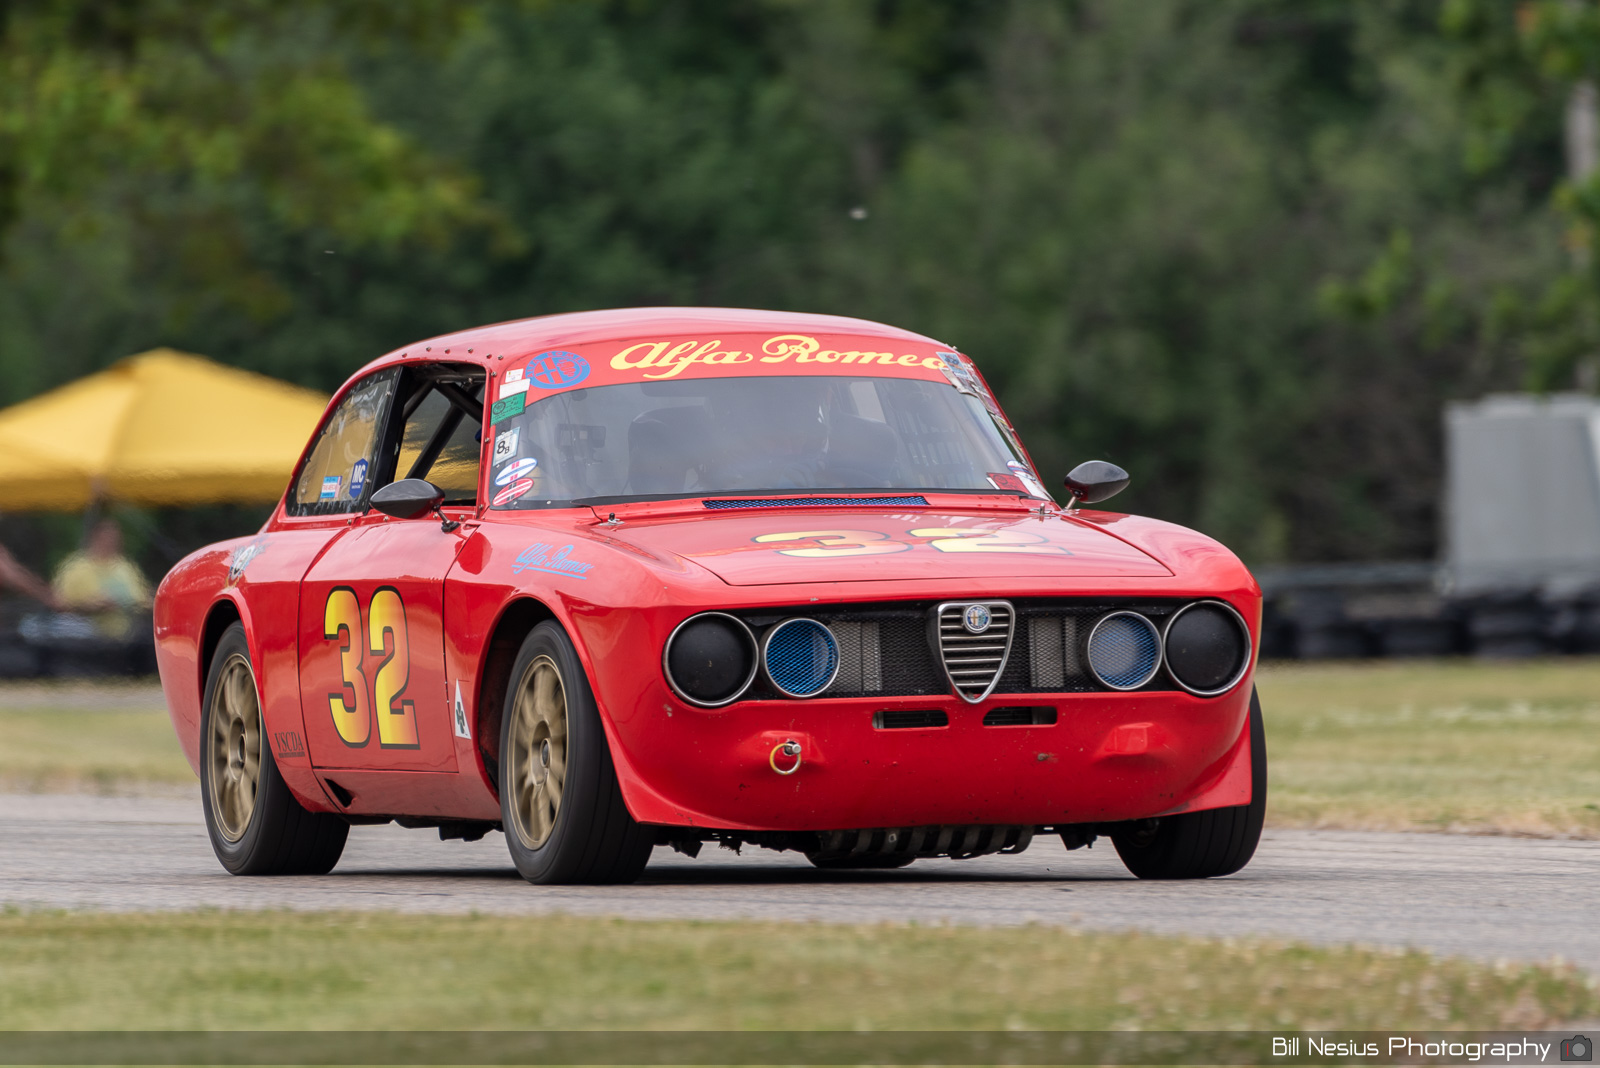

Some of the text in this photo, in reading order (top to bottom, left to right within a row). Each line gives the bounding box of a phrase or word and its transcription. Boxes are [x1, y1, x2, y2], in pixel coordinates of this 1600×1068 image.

[610, 334, 946, 379] Alfa Romeo
[351, 464, 367, 484] MC
[513, 542, 595, 575] Alfa Romeo
[749, 527, 1075, 558] 32
[323, 585, 421, 750] 32
[274, 731, 305, 752] VSCDA
